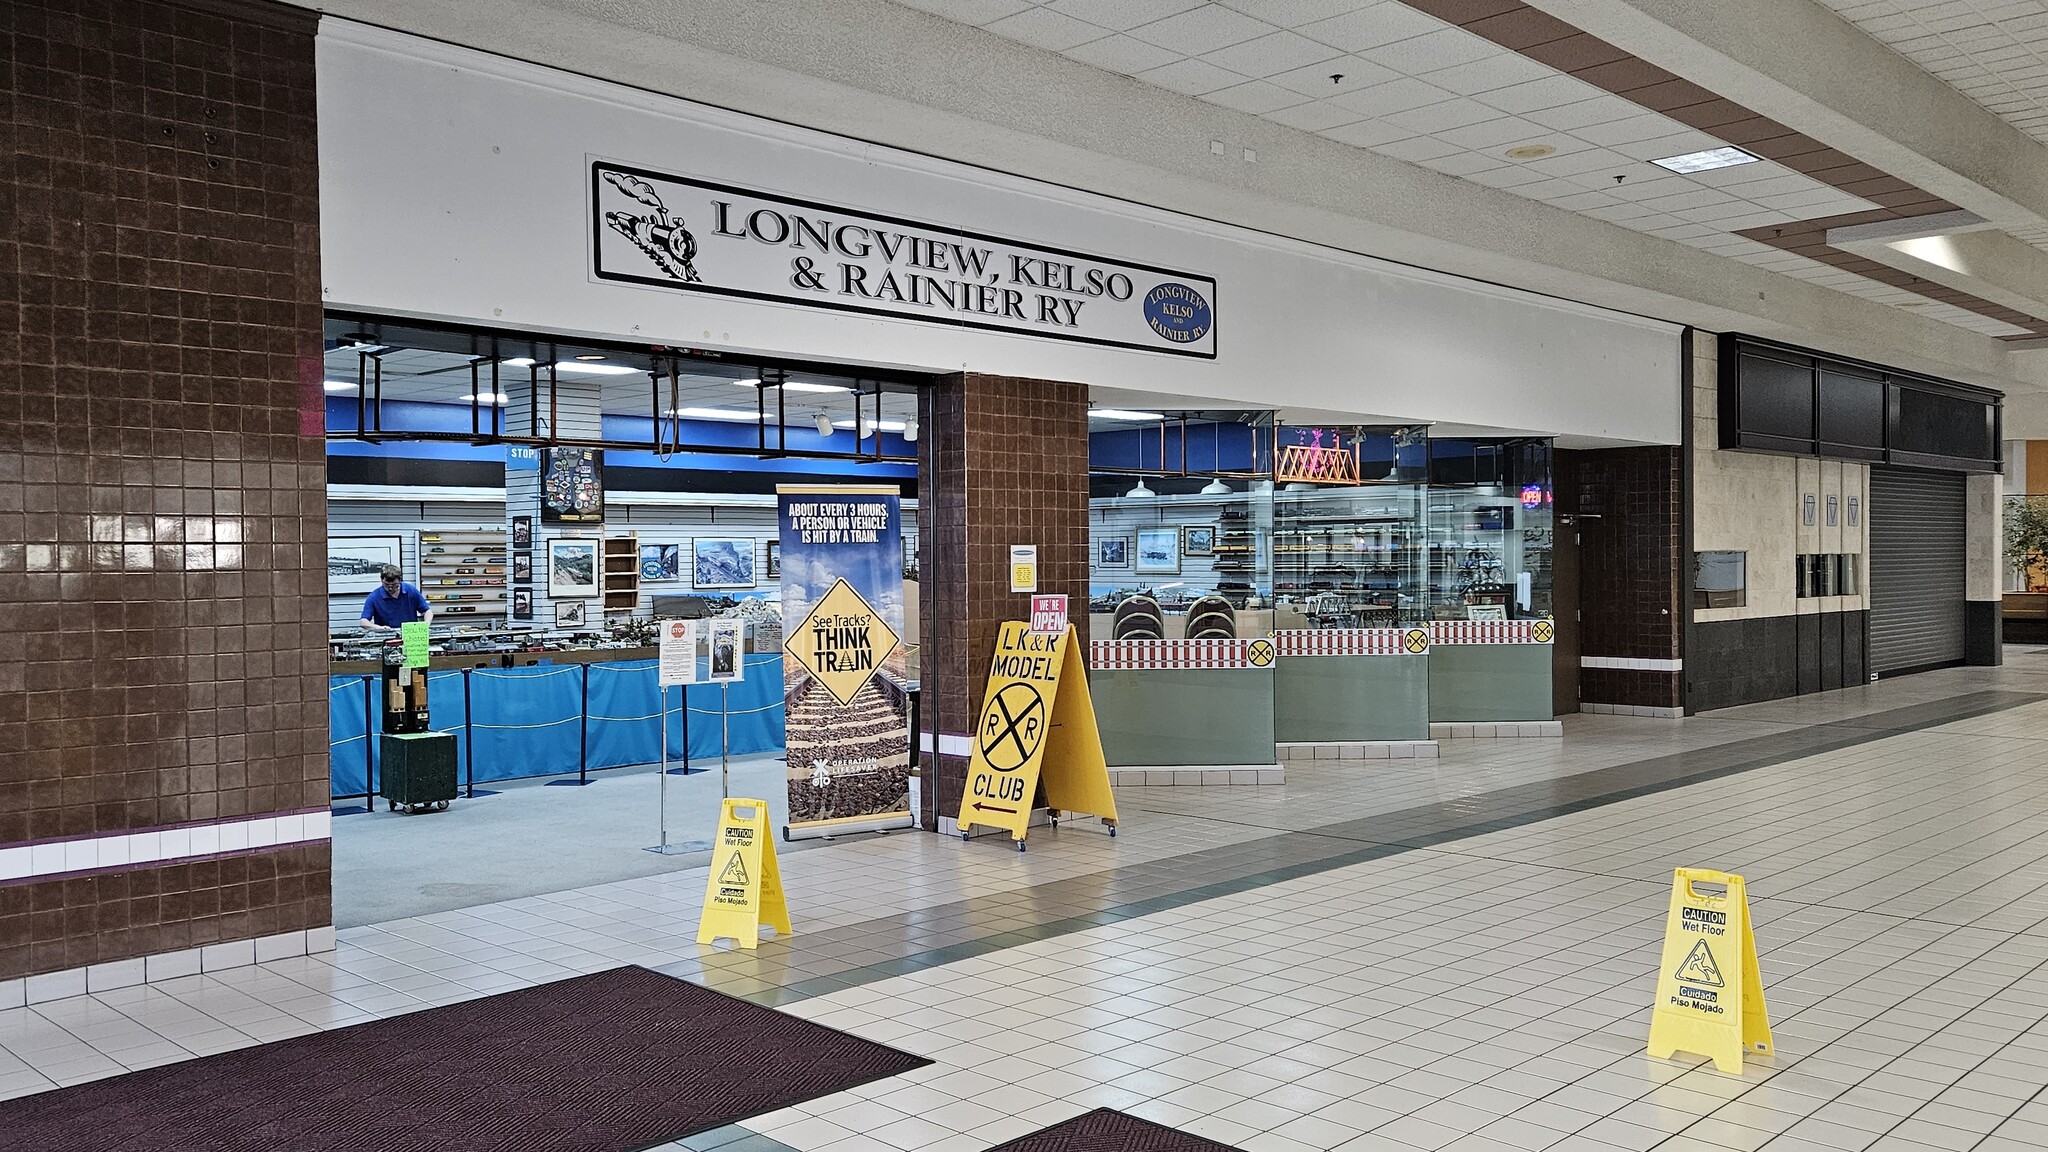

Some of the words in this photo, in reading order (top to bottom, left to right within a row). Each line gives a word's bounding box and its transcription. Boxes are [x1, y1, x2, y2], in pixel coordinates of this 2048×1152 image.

[711, 200, 999, 285] LONGVIEW,
[1008, 254, 1133, 302] KELSO
[789, 256, 829, 292] &
[837, 262, 1027, 321] RAINIER
[1035, 293, 1085, 328] RY
[1150, 286, 1206, 311] LONGVIEW
[1163, 302, 1193, 319] KELSO
[1150, 316, 1190, 341] RAINIER
[511, 448, 534, 459] STOP
[1521, 490, 1541, 503] OPEN
[788, 503, 819, 517] ABOUT
[820, 503, 848, 517] EVERY
[849, 503, 856, 516] 3
[857, 503, 889, 518] HOURS,
[792, 517, 799, 530] A
[800, 517, 836, 530] PERSON
[837, 517, 850, 530] OR
[851, 517, 887, 530] VEHICLE
[802, 530, 811, 543] IS
[812, 530, 827, 543] HIT
[829, 530, 842, 543] BY
[842, 530, 850, 542] A
[850, 530, 879, 543] TRAIN.
[1039, 599, 1059, 611] WE'RE
[812, 615, 832, 628] See
[833, 614, 871, 628] Tracks?
[1033, 611, 1064, 631] OPEN
[812, 627, 871, 650] THINK
[814, 650, 872, 673] TRAIN
[992, 655, 1056, 681] MODEL
[986, 714, 999, 736] R
[1024, 718, 1038, 740] R
[832, 757, 877, 767] OPERATION
[832, 764, 877, 774] LIFESAVER
[974, 774, 1025, 801] CLUB
[725, 828, 753, 838] CAUTION
[725, 838, 736, 846] Wet
[737, 839, 752, 847] Floor
[720, 888, 744, 897] Cuidado
[714, 895, 726, 904] Piso
[727, 897, 748, 906] Mojado
[1683, 908, 1726, 925] CAUTION
[1682, 920, 1699, 933] Wet
[1702, 922, 1725, 936] Floor
[1680, 987, 1717, 1002] Cuidado
[1670, 996, 1689, 1008] Piso
[1692, 1001, 1724, 1014] Mojado
